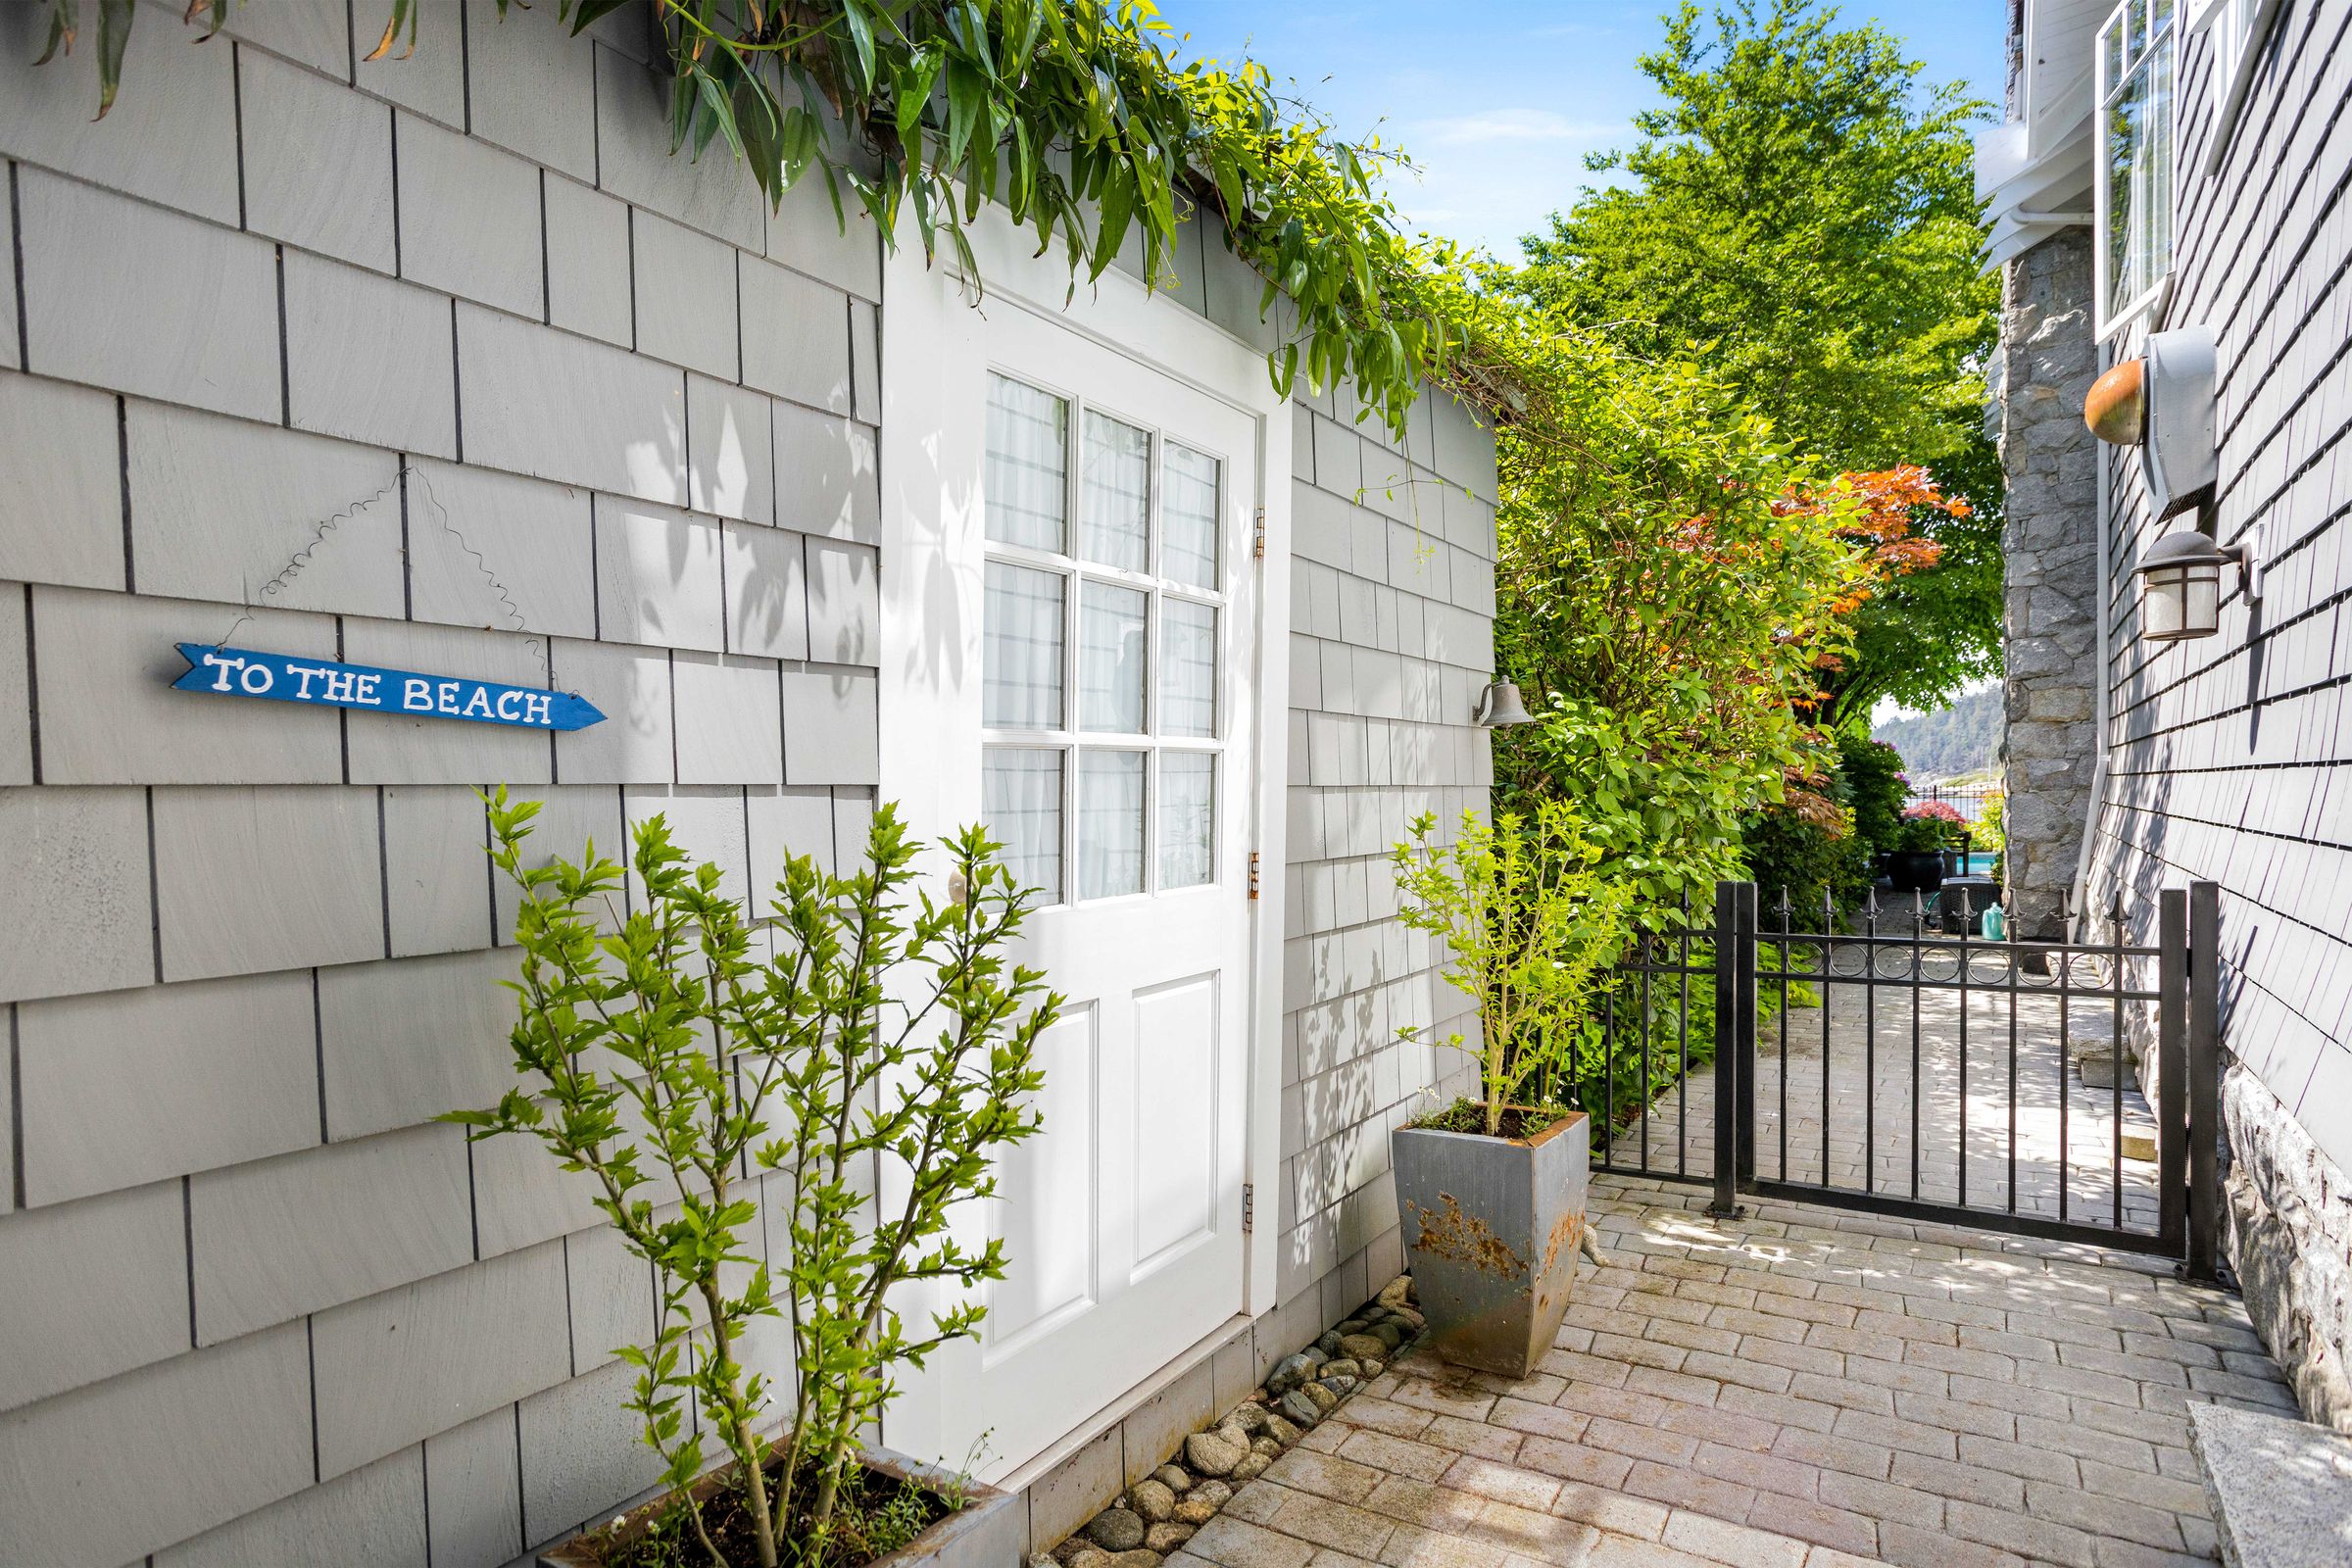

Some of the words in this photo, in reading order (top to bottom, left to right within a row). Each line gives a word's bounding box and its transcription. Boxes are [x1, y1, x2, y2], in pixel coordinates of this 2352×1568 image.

[203, 653, 273, 694] TO
[286, 663, 381, 706] THE
[403, 678, 552, 725] BEACH
